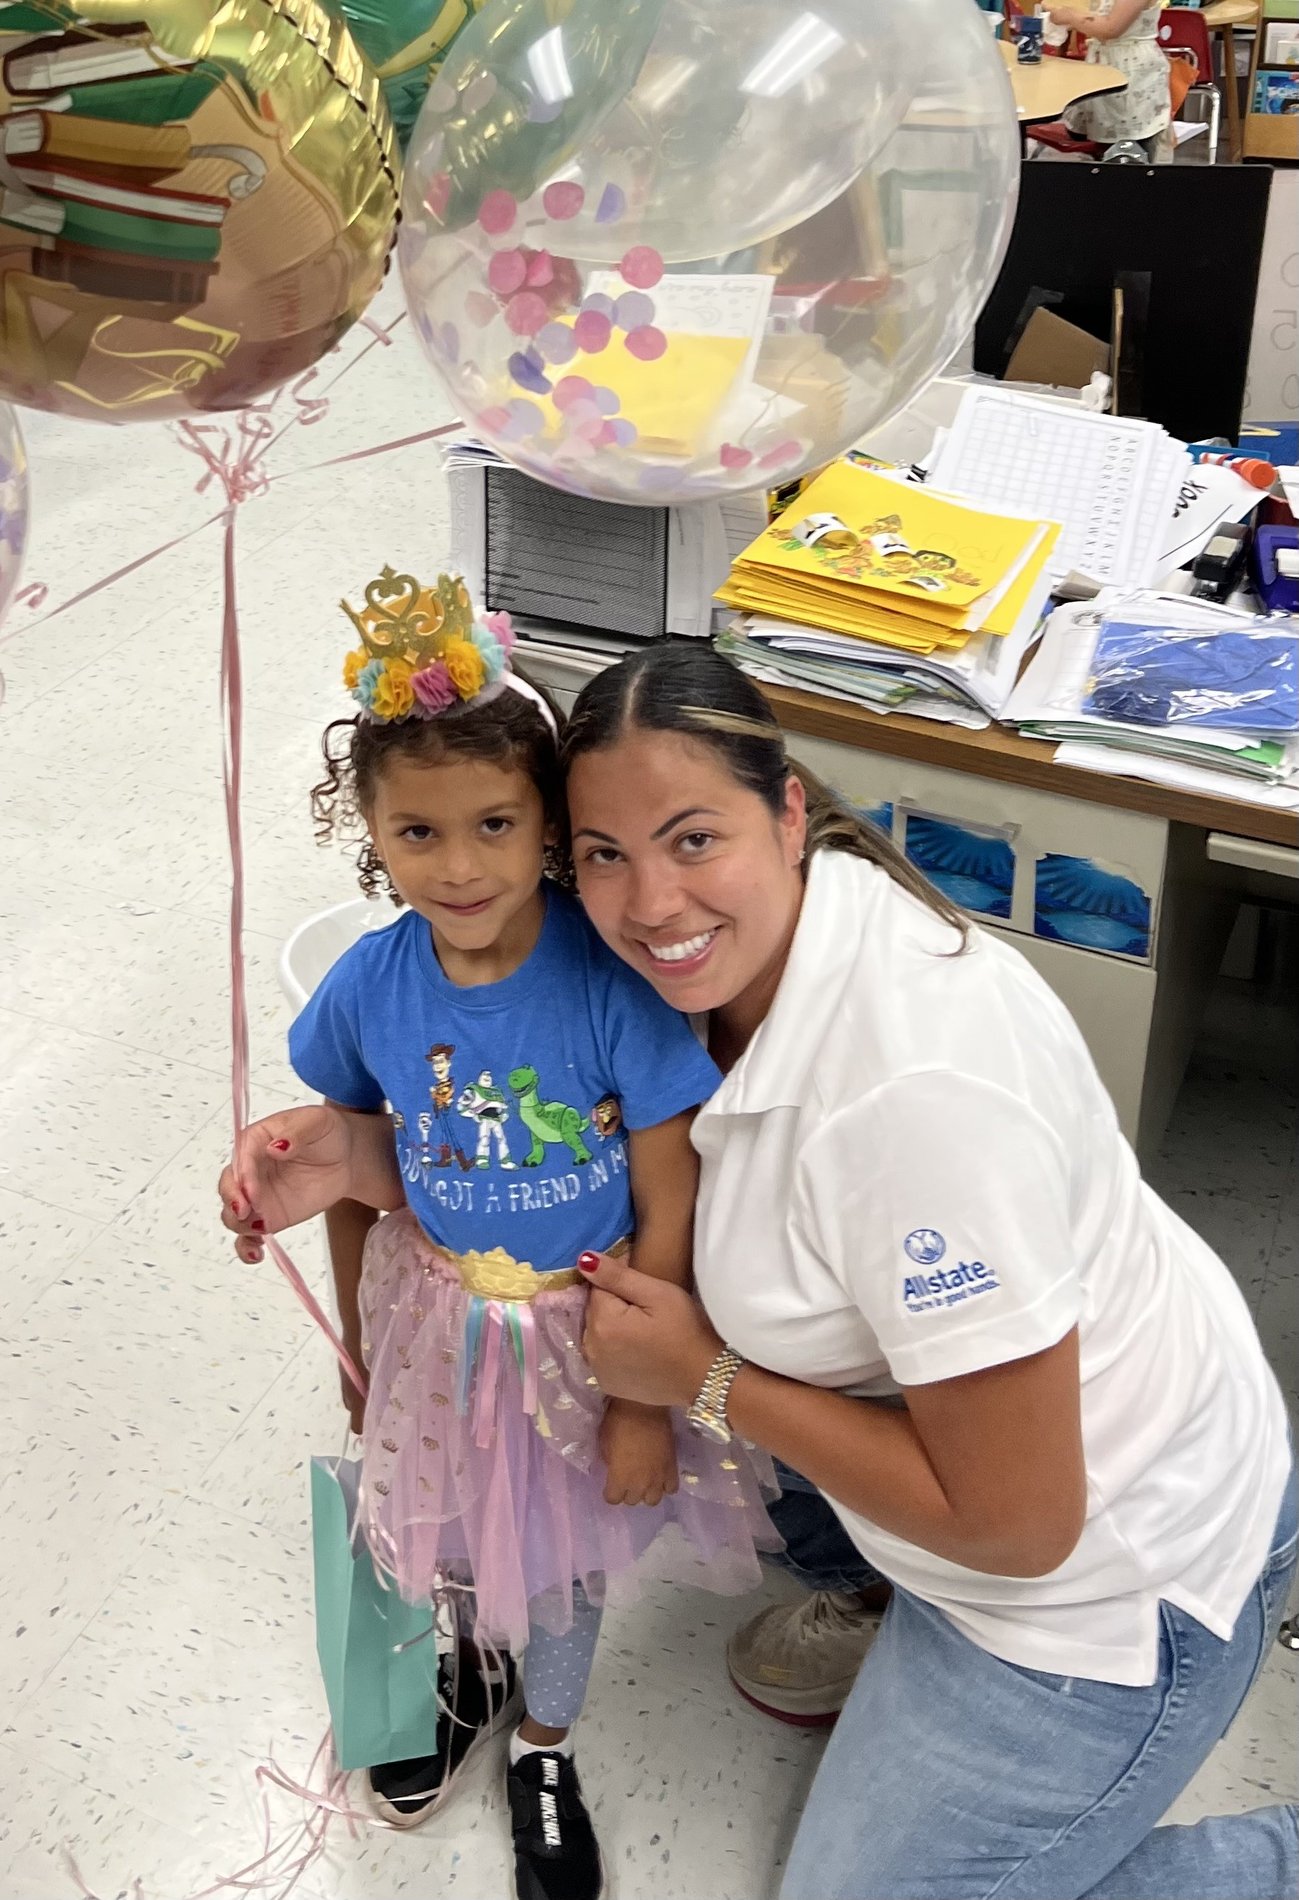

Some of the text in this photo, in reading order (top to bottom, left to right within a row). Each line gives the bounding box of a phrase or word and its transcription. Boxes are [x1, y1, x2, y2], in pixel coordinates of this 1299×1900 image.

[485, 1183, 501, 1213] A
[508, 1173, 580, 1212] FRIEND
[610, 1143, 629, 1174] M
[903, 1261, 988, 1301] Allstate
[541, 1757, 559, 1787] NIKE
